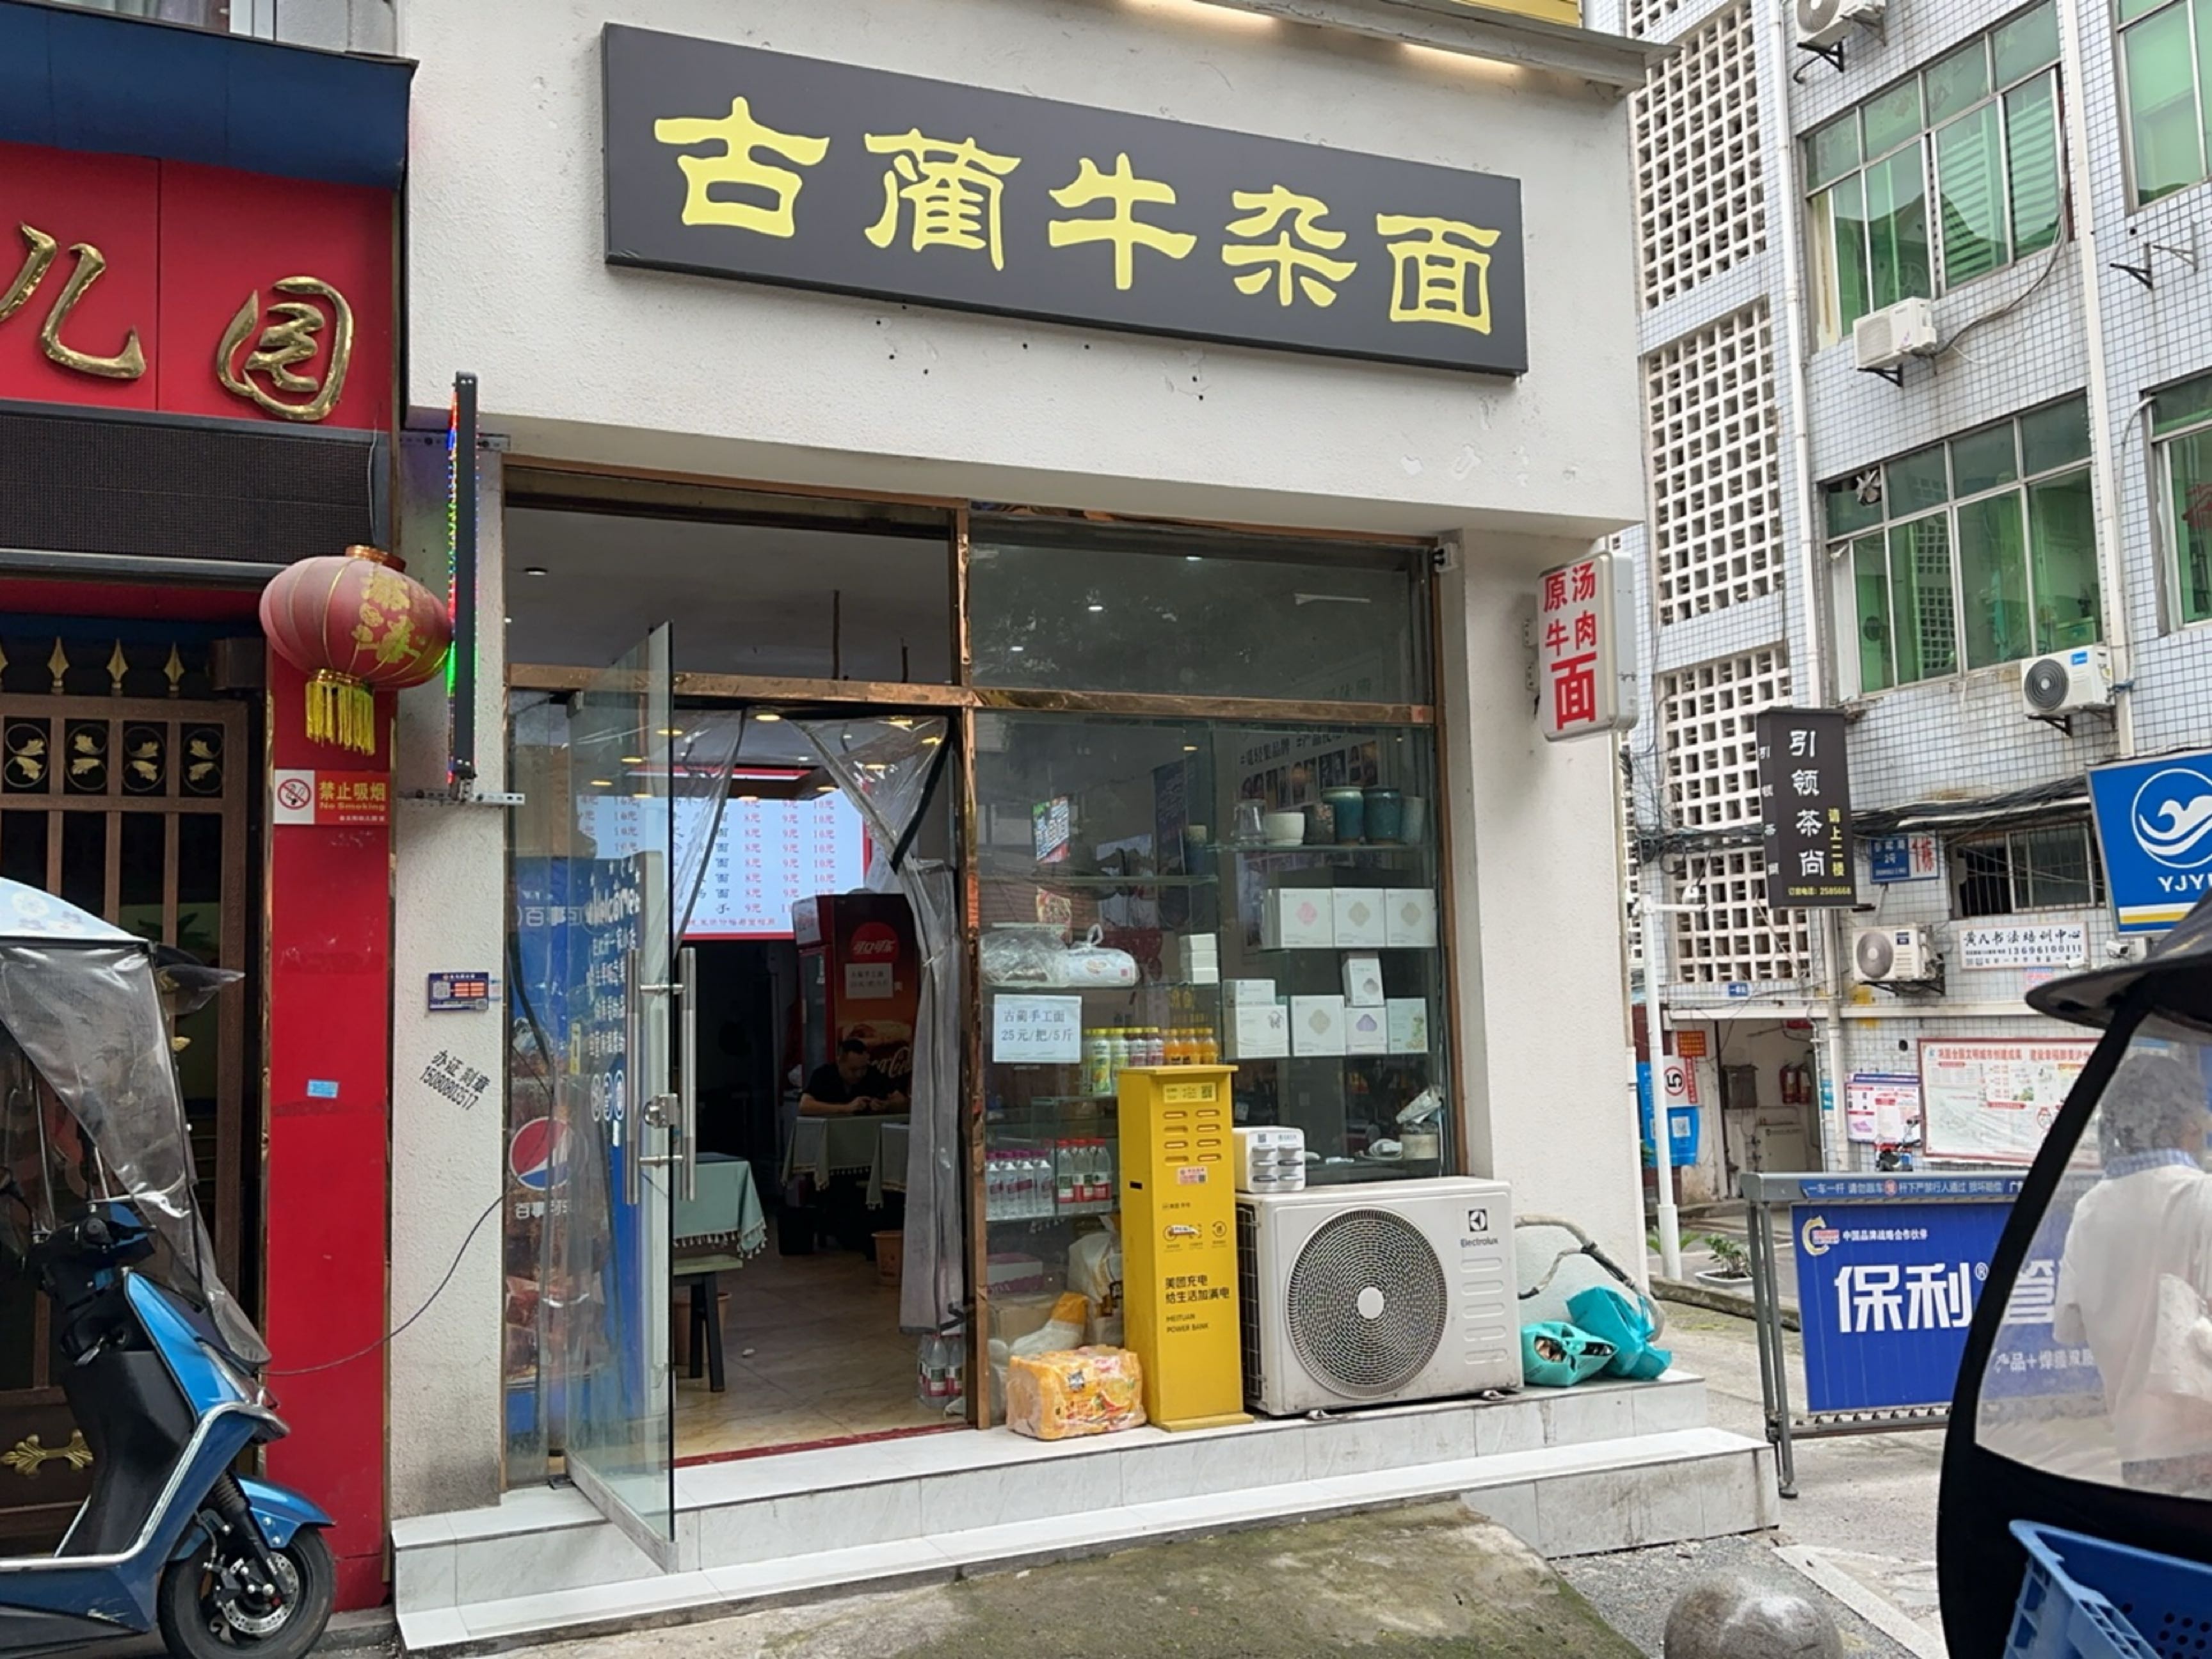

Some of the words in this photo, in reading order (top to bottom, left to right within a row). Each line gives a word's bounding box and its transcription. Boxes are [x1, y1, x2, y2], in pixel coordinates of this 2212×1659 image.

[653, 96, 1500, 334] 古蔺牛杂面
[1543, 561, 1596, 613] 原汤
[1545, 609, 1597, 657] 牛肉
[1550, 650, 1598, 731] 面
[319, 780, 387, 801] 禁止吸烟
[337, 801, 386, 812] Smoking
[1789, 729, 1825, 877] 引领茶尚
[1165, 1274, 1208, 1290] 美团充电
[1166, 1286, 1230, 1305] 给生活加满电
[1834, 1262, 1973, 1333] 保利
[1166, 1313, 1196, 1322] MEITUAN
[1166, 1324, 1190, 1333] POWER
[1192, 1322, 1209, 1332] BANK
